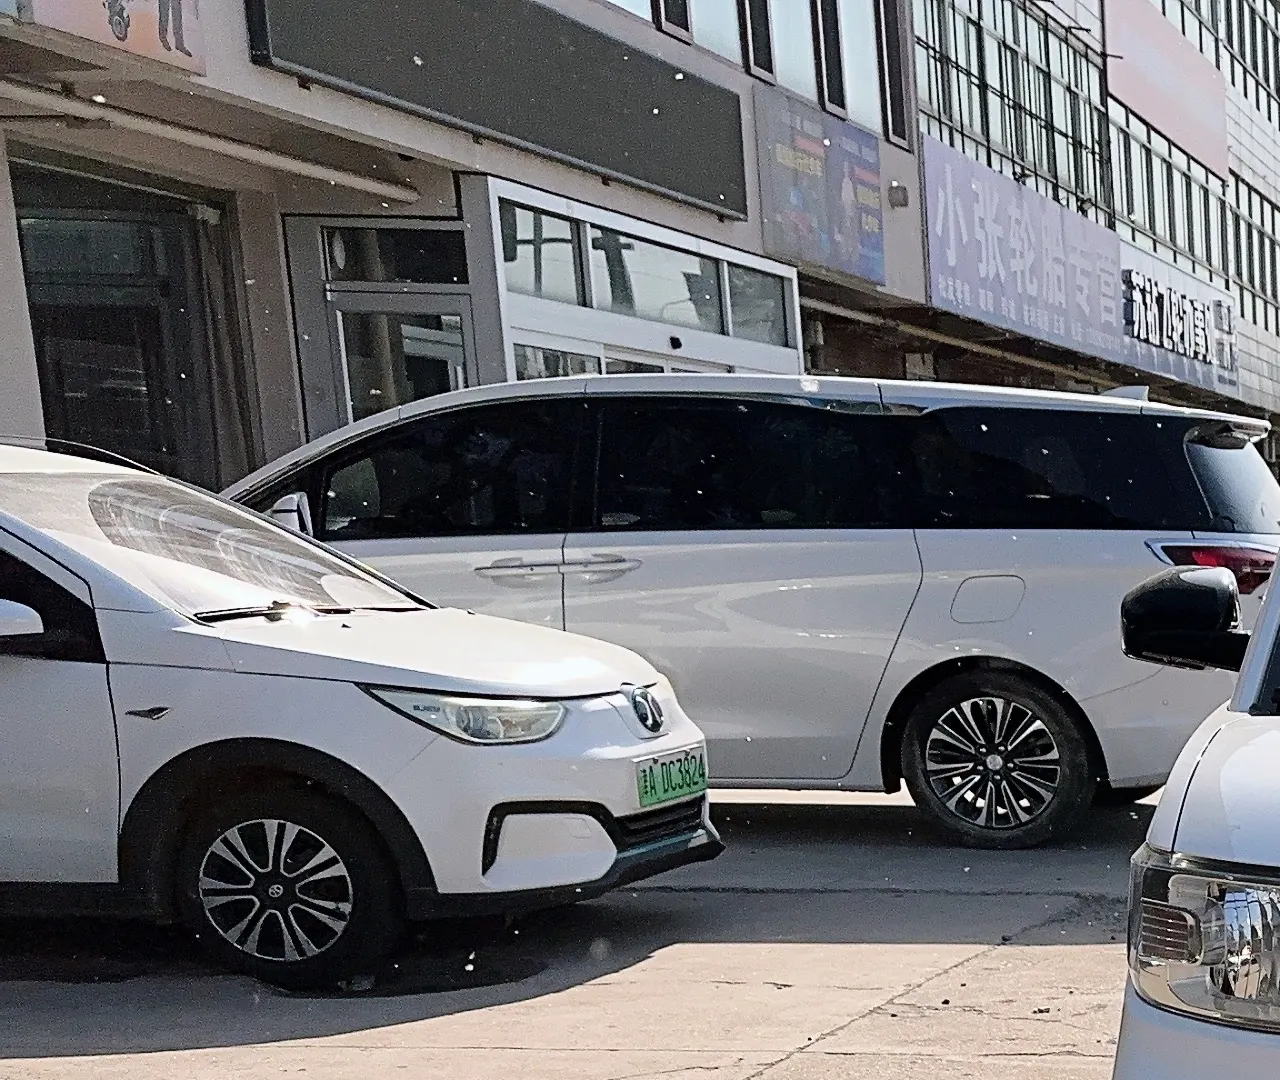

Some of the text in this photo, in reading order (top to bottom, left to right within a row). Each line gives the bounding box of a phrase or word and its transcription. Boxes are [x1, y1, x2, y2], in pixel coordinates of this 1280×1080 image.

[935, 162, 1118, 327] 小张轮胎专营
